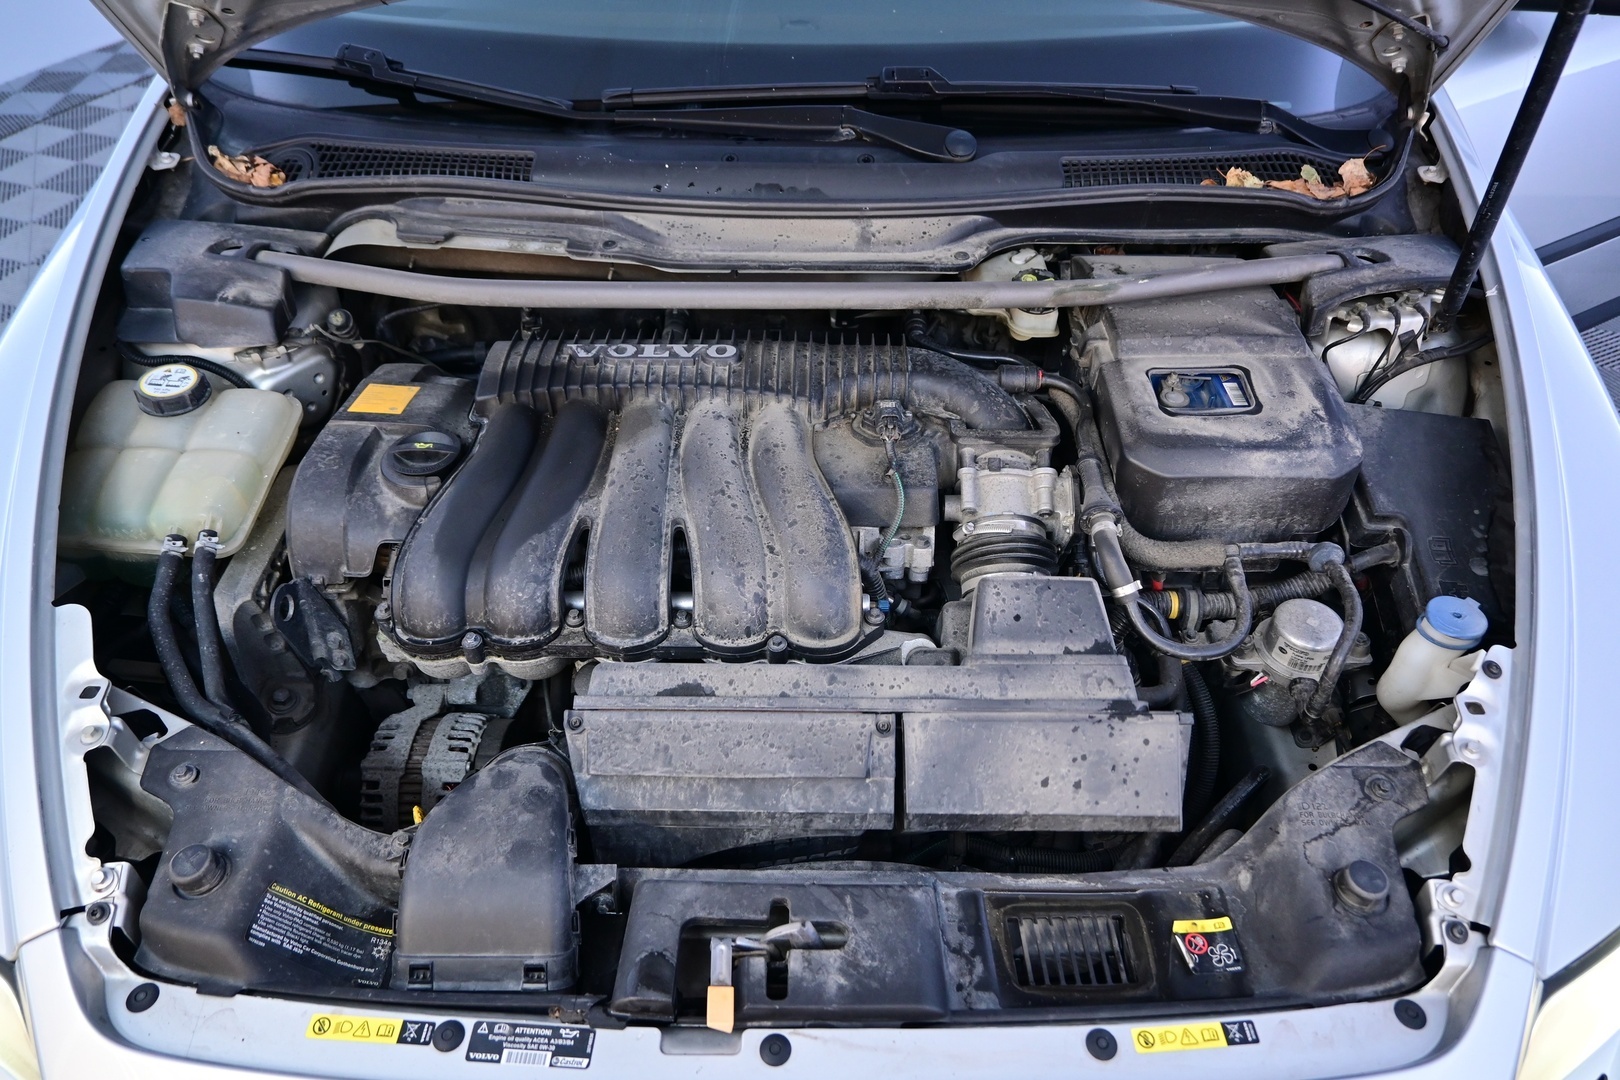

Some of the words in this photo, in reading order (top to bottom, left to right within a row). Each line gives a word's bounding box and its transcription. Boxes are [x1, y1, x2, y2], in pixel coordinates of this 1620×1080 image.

[567, 344, 737, 358] VOLVO
[272, 883, 296, 897] Caution
[297, 894, 307, 902] AC
[308, 899, 342, 919] Refrigerant
[344, 917, 362, 927] under
[363, 924, 393, 934] pressure
[274, 902, 286, 910] Volvo
[287, 908, 302, 917] service
[279, 899, 297, 910] serviced
[303, 910, 322, 920] qualified
[322, 919, 344, 930] personnel.
[262, 910, 292, 925] Recommended
[292, 923, 312, 934] refrigerant
[260, 914, 275, 924] System
[276, 921, 292, 931] contains
[323, 942, 340, 951] detection
[267, 923, 286, 934] ultraviolet
[303, 923, 325, 934] compressor
[250, 929, 270, 941] complies
[252, 924, 283, 940] Manufactured
[290, 940, 302, 948] Volvo
[311, 949, 336, 962] Corporation
[337, 959, 364, 971] Gothenburg
[370, 937, 392, 946] R134a
[515, 1027, 552, 1036] ATTENTION!
[488, 1034, 506, 1042] Engine
[469, 1052, 500, 1060] VOLVO
[560, 1058, 584, 1066] Castrol
